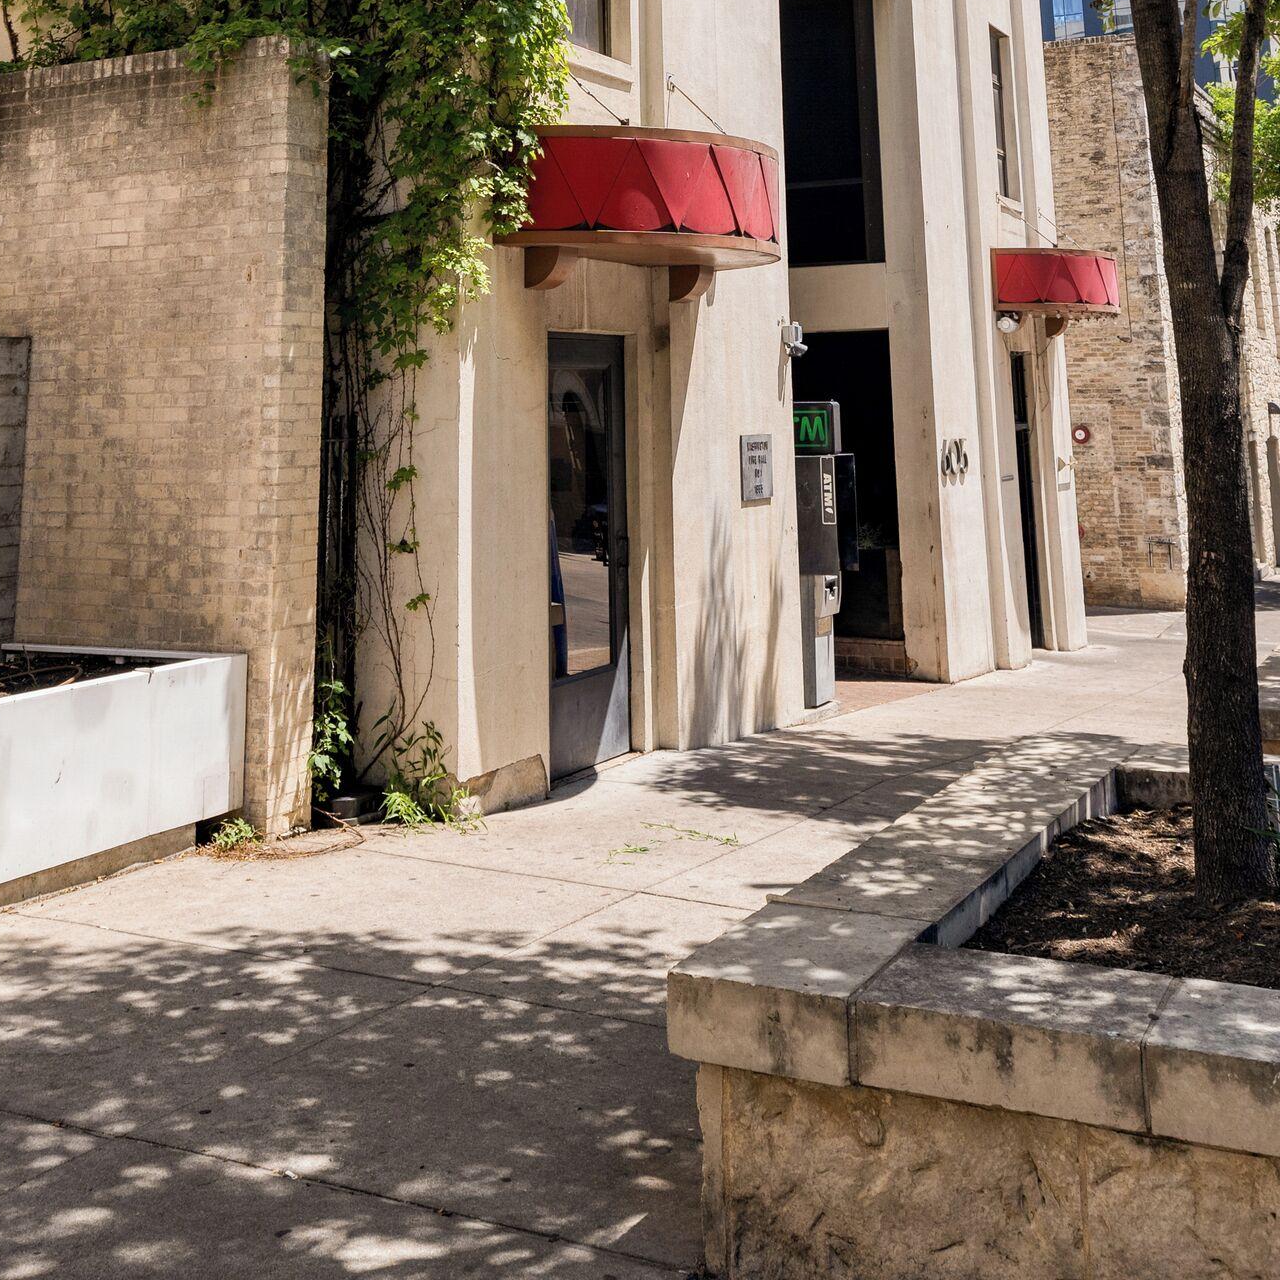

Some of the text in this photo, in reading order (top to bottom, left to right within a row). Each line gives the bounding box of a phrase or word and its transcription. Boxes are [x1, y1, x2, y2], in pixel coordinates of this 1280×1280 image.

[794, 416, 825, 442] M
[941, 438, 969, 477] 605
[823, 473, 834, 507] ATM
